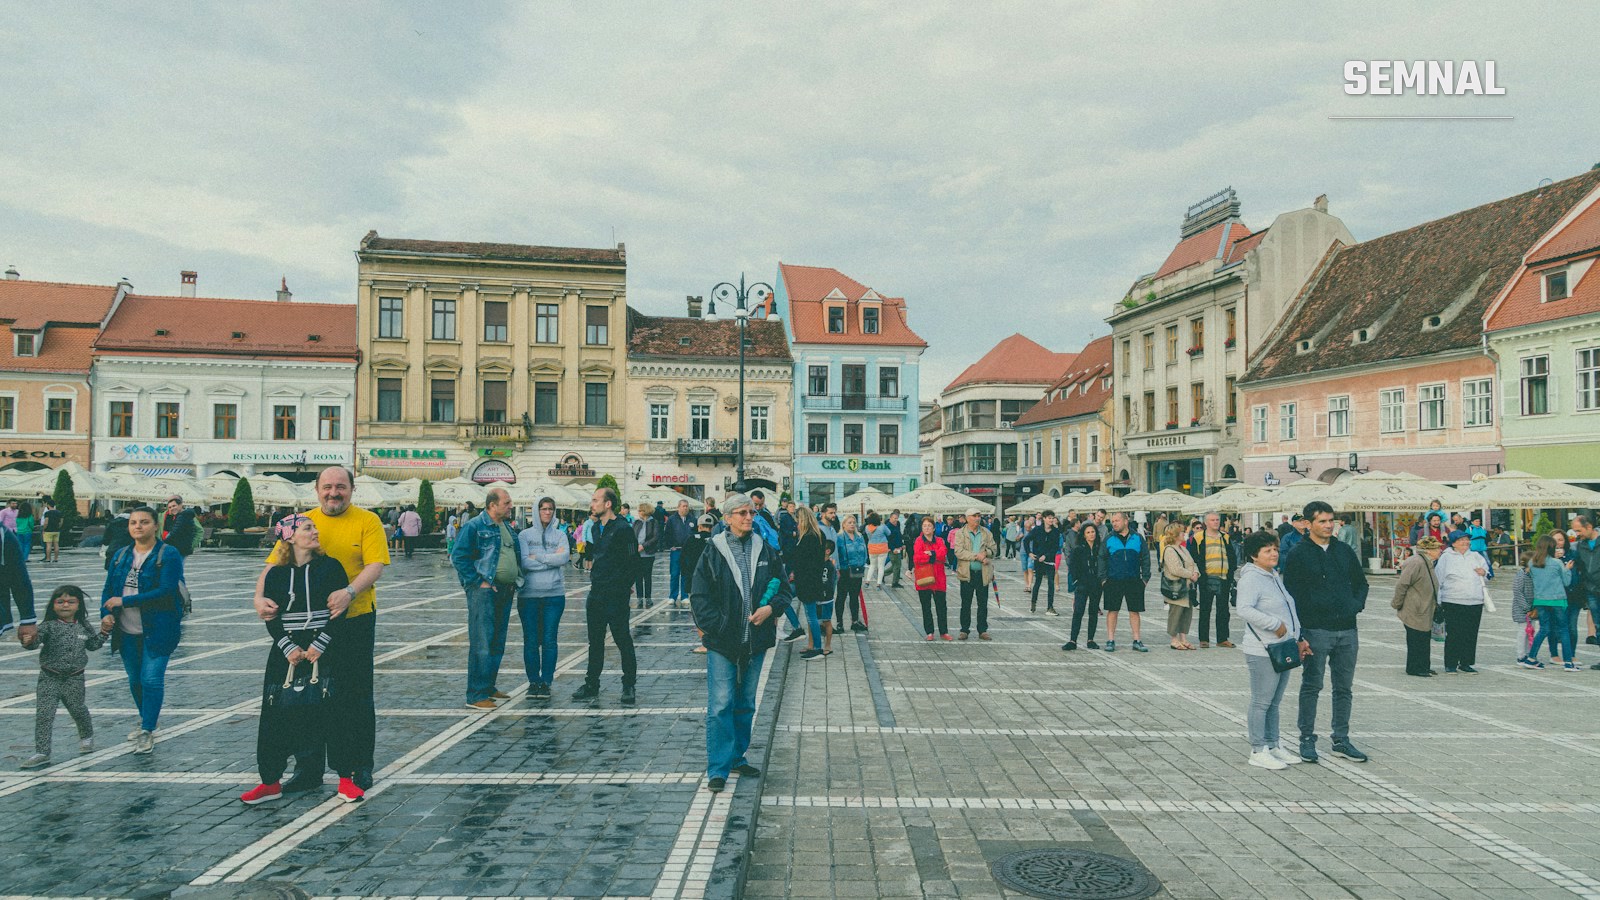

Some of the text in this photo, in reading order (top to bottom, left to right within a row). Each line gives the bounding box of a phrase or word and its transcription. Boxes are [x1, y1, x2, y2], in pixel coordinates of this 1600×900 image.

[1146, 435, 1187, 448] BRASSERIE
[123, 444, 176, 455] GO GREEK
[412, 449, 447, 459] BACK
[233, 453, 345, 461] RESTAURANT ROMA
[821, 459, 892, 470] CEC Bank
[652, 473, 696, 483] inmedio
